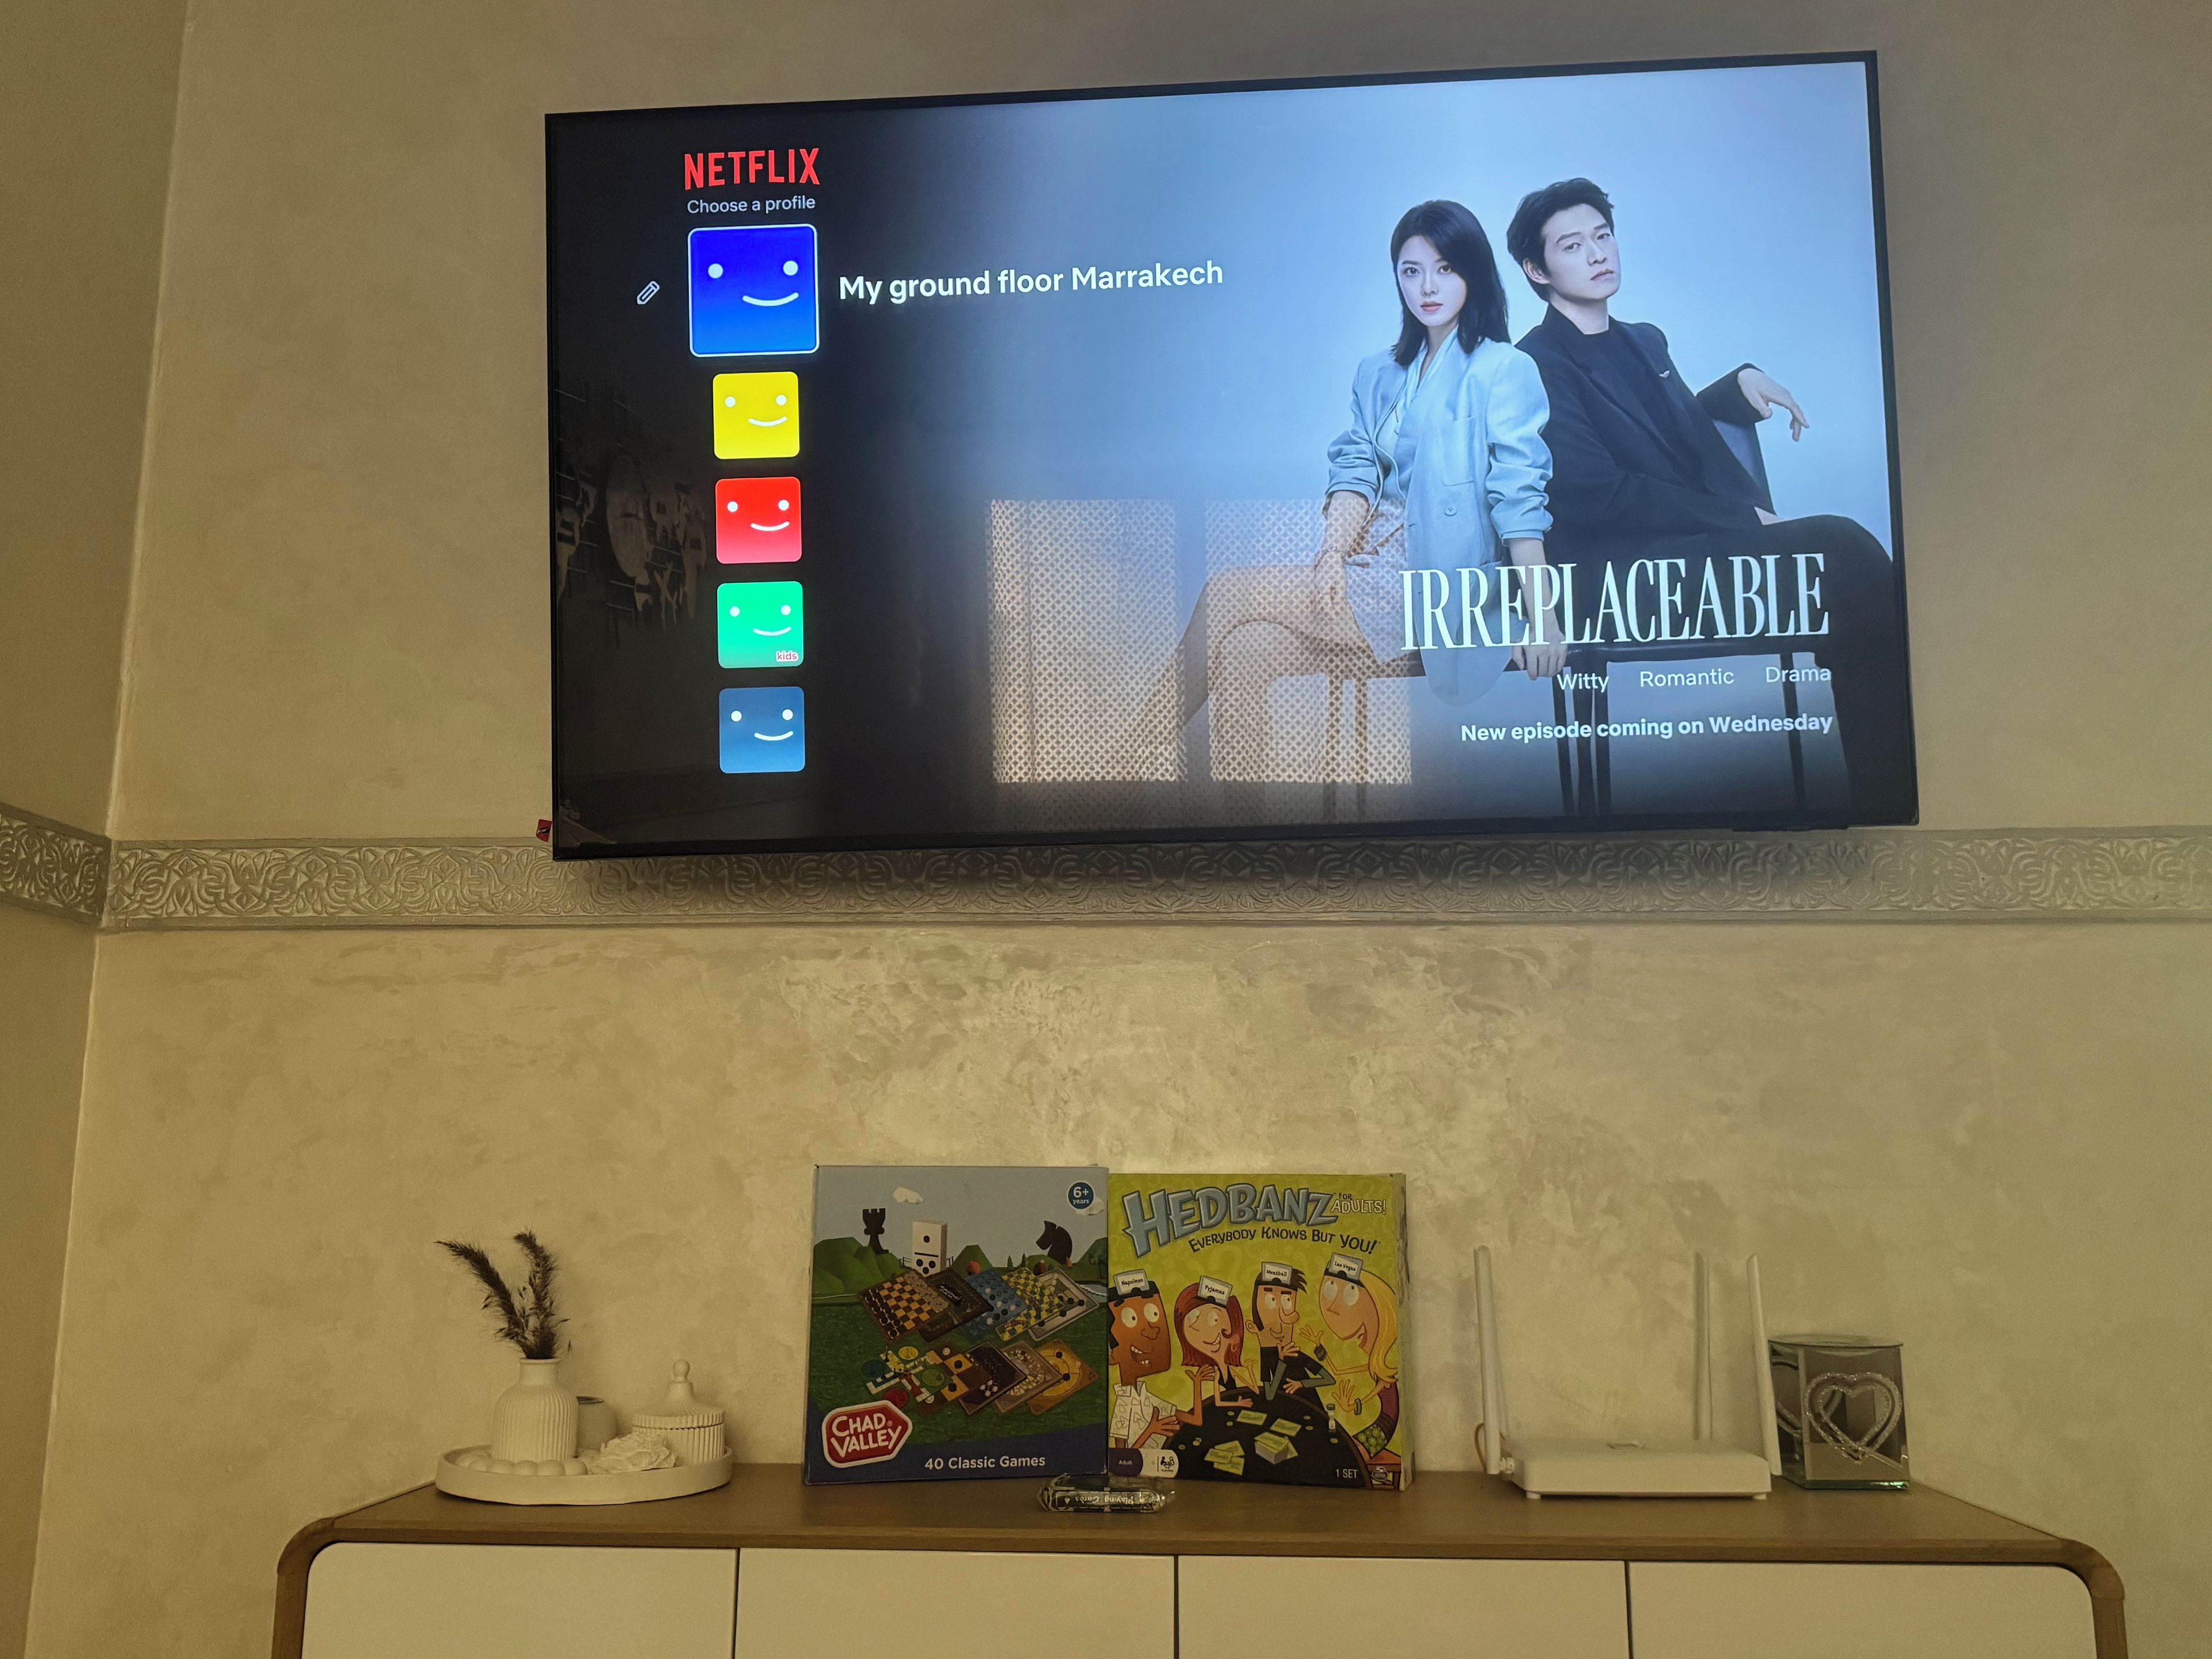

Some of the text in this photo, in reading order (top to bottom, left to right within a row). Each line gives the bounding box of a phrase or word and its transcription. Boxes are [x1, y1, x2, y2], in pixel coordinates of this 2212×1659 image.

[684, 147, 820, 191] NETFLIX
[687, 195, 816, 214] Choose a profile
[839, 260, 1224, 305] My ground floor Marrakech
[1399, 552, 1830, 652] IRREPLACEABLE
[777, 651, 798, 660] kids
[1556, 666, 1832, 694] Witty Romantic Drama
[1460, 713, 1834, 744] New episode coming on Wednesday
[1073, 1186, 1089, 1198] 6+
[1339, 1192, 1353, 1201] FOR
[1330, 1199, 1387, 1215] ADULTS!
[1122, 1183, 1339, 1259] HEDBANZ
[1188, 1226, 1378, 1255] EVERYBODY KNOWS BUT YOU!
[1266, 1269, 1287, 1277] Meatball
[1343, 1264, 1356, 1272] Vegas
[1121, 1278, 1143, 1286] Napoleon
[1205, 1285, 1225, 1295] Pyjamas
[832, 1412, 887, 1437] CHAD
[830, 1425, 902, 1459] VALLEY
[925, 1455, 1040, 1469] 40 Classic Games
[1335, 1468, 1358, 1479] 1 SET
[1104, 1495, 1134, 1505] Playing
